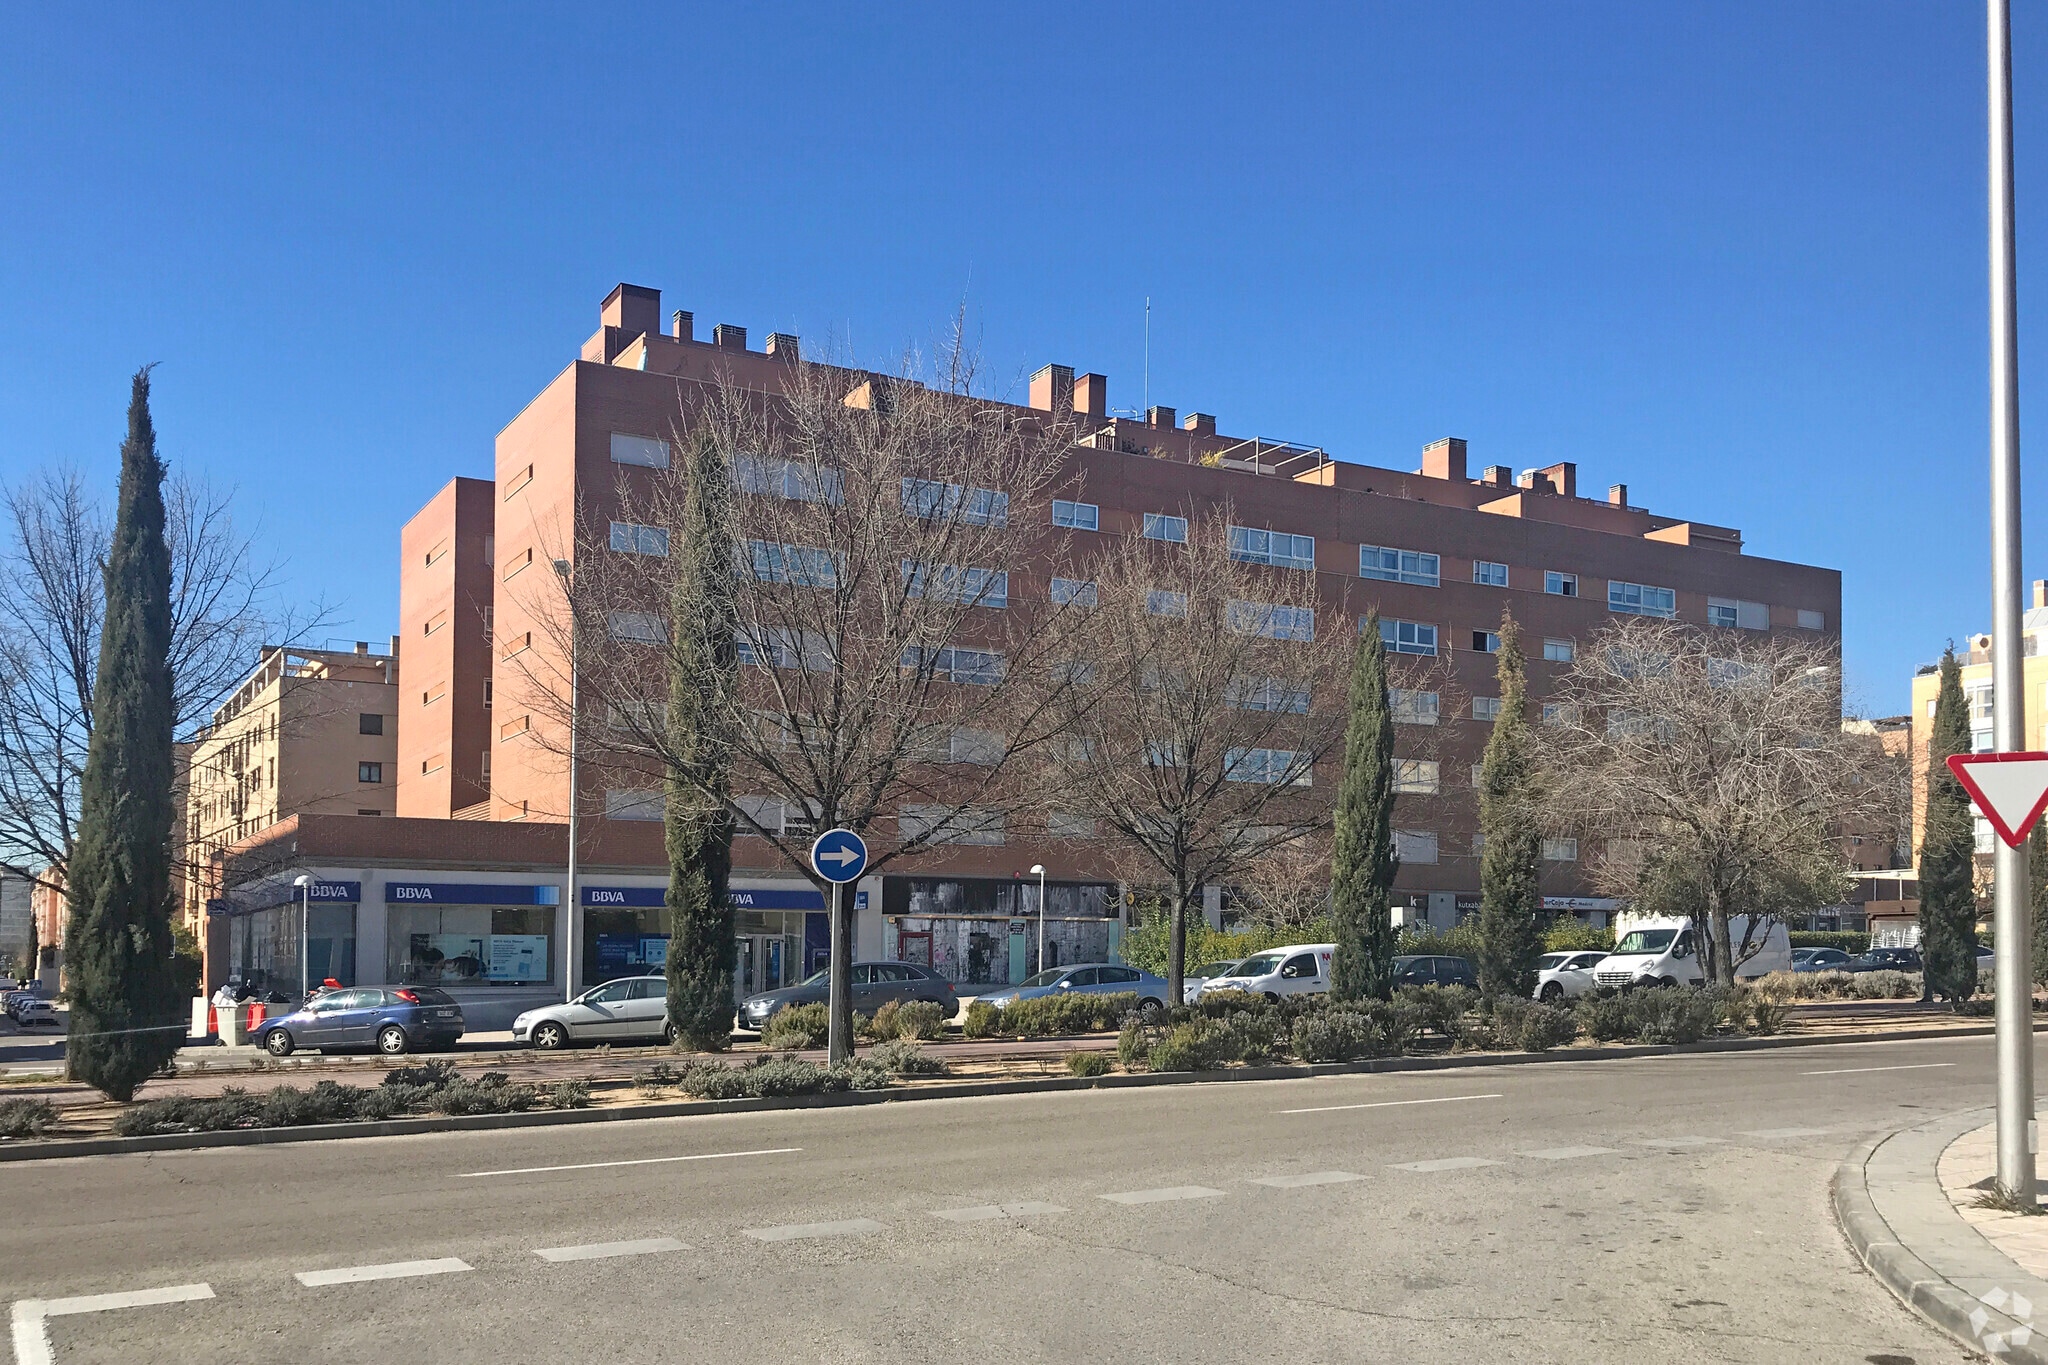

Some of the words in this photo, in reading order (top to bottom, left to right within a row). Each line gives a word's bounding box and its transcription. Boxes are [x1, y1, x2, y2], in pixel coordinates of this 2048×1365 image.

[310, 885, 348, 898] BBVA
[396, 887, 433, 899] BBVA
[591, 890, 625, 903] BBVA
